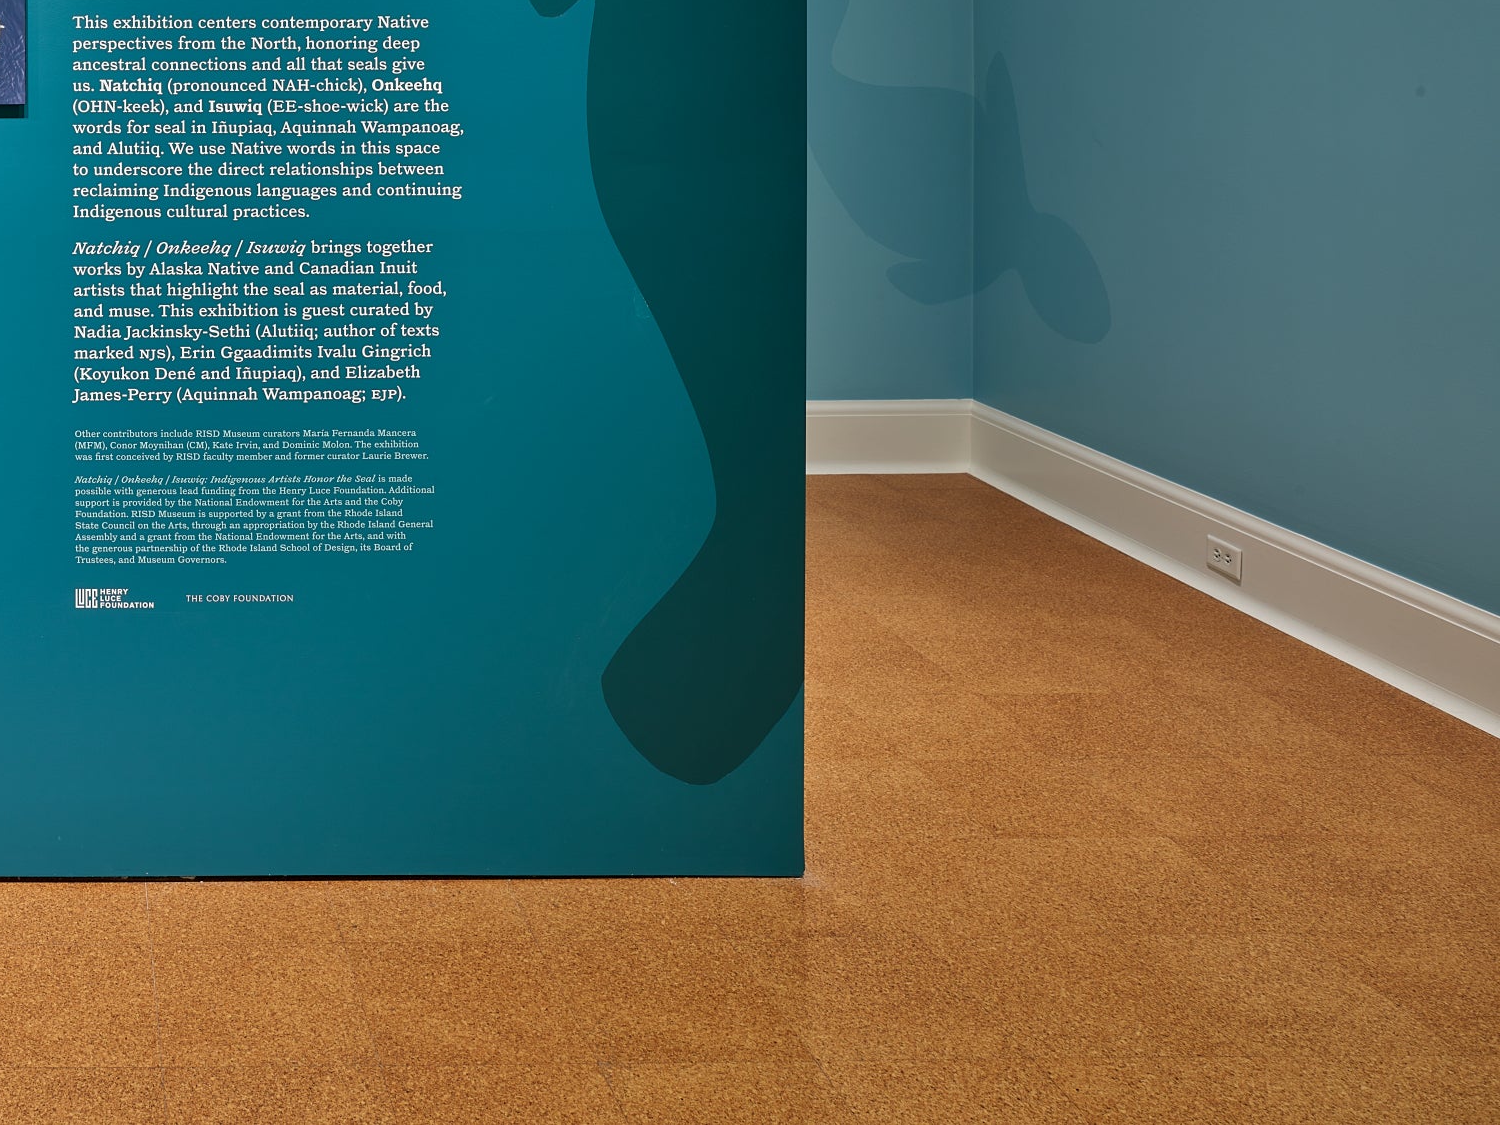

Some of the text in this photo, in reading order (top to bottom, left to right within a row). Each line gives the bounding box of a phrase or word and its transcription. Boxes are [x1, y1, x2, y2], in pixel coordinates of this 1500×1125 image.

[72, 14, 429, 32] This exhibition centers contemporary Native
[73, 77, 443, 95] us. Natchiq (pronounced NAH-chick), Onkeehq
[72, 98, 449, 116] (OHN-keek), and Isuwiq (EE-shoe-wick) are the
[72, 240, 140, 257] Natchiq
[156, 240, 232, 257] Onkeehq
[246, 240, 306, 257] Isuwiq
[310, 240, 361, 257] brings
[366, 239, 434, 257] together
[74, 322, 439, 341] Nadia Jackinsky-Sethi (Alutiiq; author of texts
[74, 364, 421, 384] (Koyukon Dené and Iñupiaq), and Elizabeth
[72, 385, 406, 404] James-Perry (Aquinnah Wampanoag; EJP).
[75, 430, 101, 438] Other
[103, 429, 158, 438] contributors
[160, 429, 193, 437] include
[263, 429, 300, 437] curators
[303, 429, 329, 437] María
[332, 429, 375, 437] Fernanda
[377, 429, 416, 437] Mancera
[95, 452, 113, 460] first
[116, 452, 160, 460] conceived
[163, 452, 174, 462] by
[203, 452, 234, 462] faculty
[236, 452, 273, 460] member
[275, 452, 291, 460] and
[294, 452, 325, 460] former
[75, 556, 116, 565] Trustees,
[118, 555, 135, 563] and
[185, 594, 294, 603] THE COBY FOUNDATION
